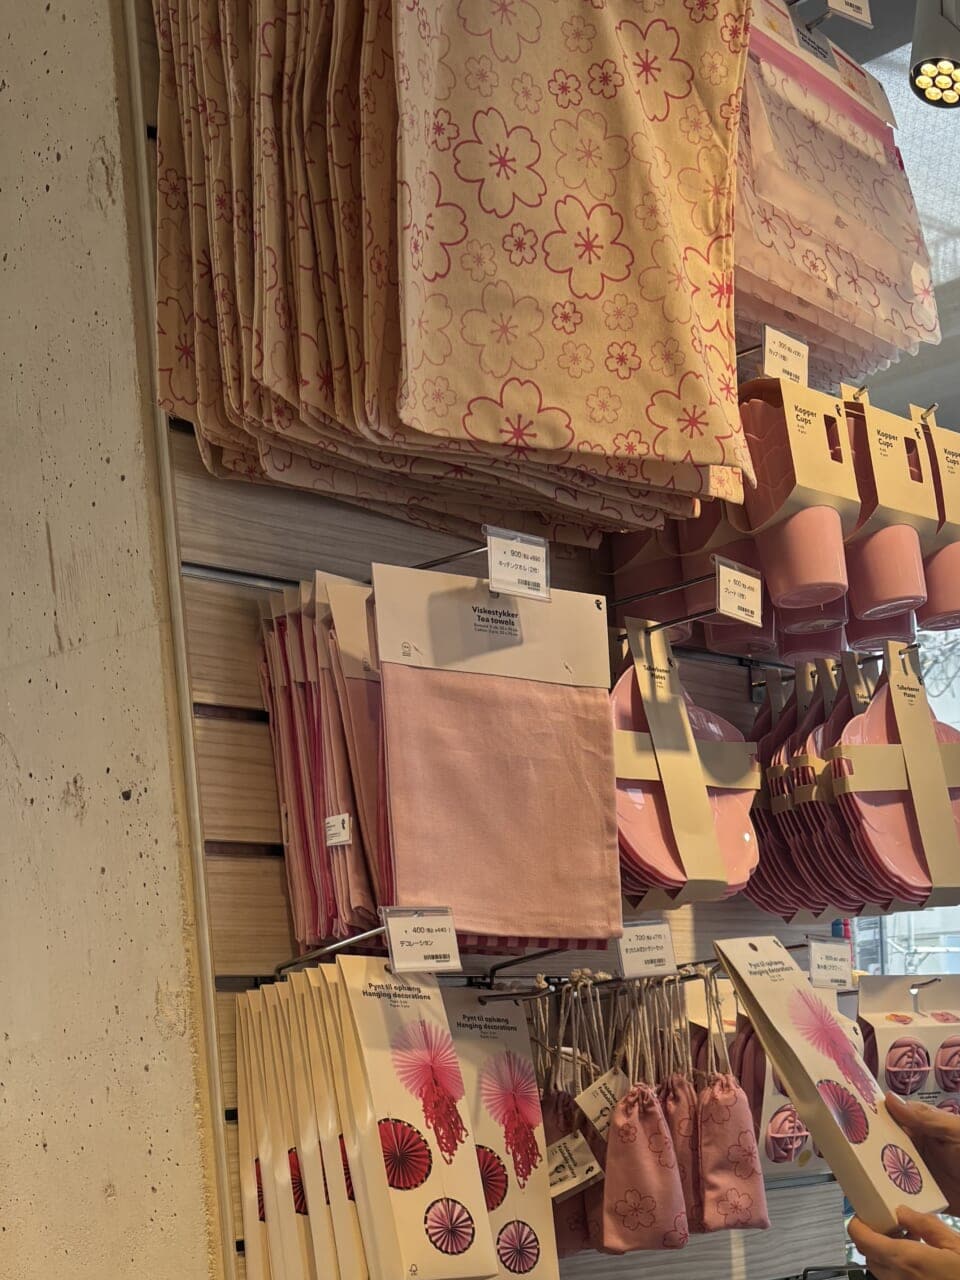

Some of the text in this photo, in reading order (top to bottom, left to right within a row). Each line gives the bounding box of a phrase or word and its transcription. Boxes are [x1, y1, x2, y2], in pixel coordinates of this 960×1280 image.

[794, 404, 817, 418] Kopper
[796, 414, 812, 425] Cups
[877, 429, 898, 441] Kopper
[878, 438, 894, 449] Cups
[945, 456, 960, 466] Cups
[510, 549, 522, 559] 900
[471, 606, 519, 619] Viskestykker
[477, 614, 515, 627] Tea towels
[412, 926, 425, 934] 400
[367, 982, 422, 994] Pynt til ophæng
[362, 989, 432, 1001] Hanging decorations
[462, 1014, 477, 1022] Pynt
[484, 1015, 510, 1025] ophæng
[456, 1021, 518, 1032] Hanging decorations
